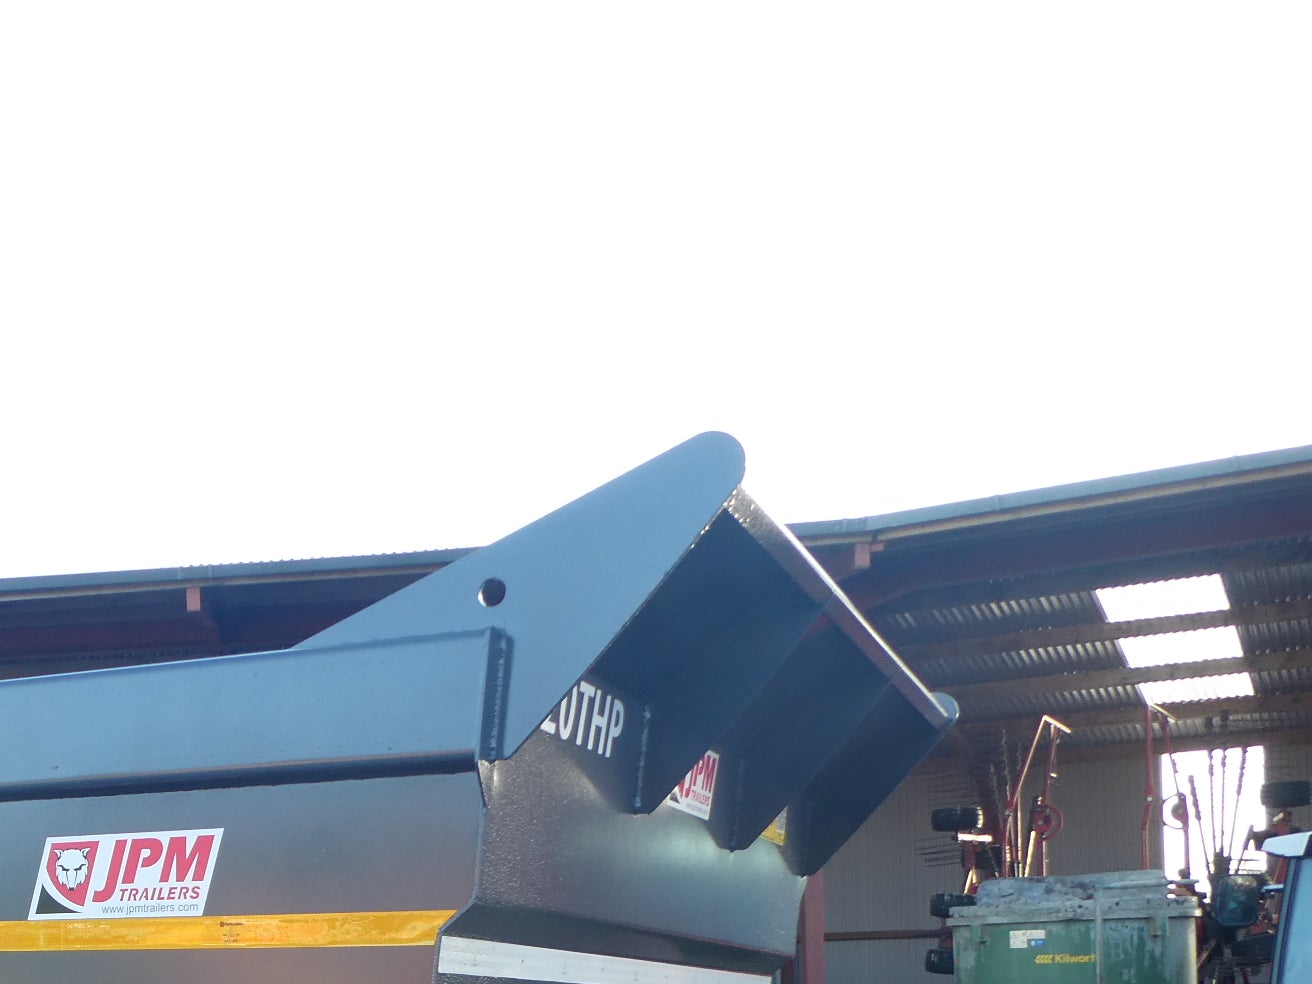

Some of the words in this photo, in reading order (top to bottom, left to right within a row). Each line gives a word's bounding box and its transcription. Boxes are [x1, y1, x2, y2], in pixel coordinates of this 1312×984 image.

[92, 834, 215, 903] JPM
[119, 886, 201, 902] TRAILERS
[101, 902, 199, 915] www.jpmtrailers.com
[1054, 953, 1097, 964] Kilwort
